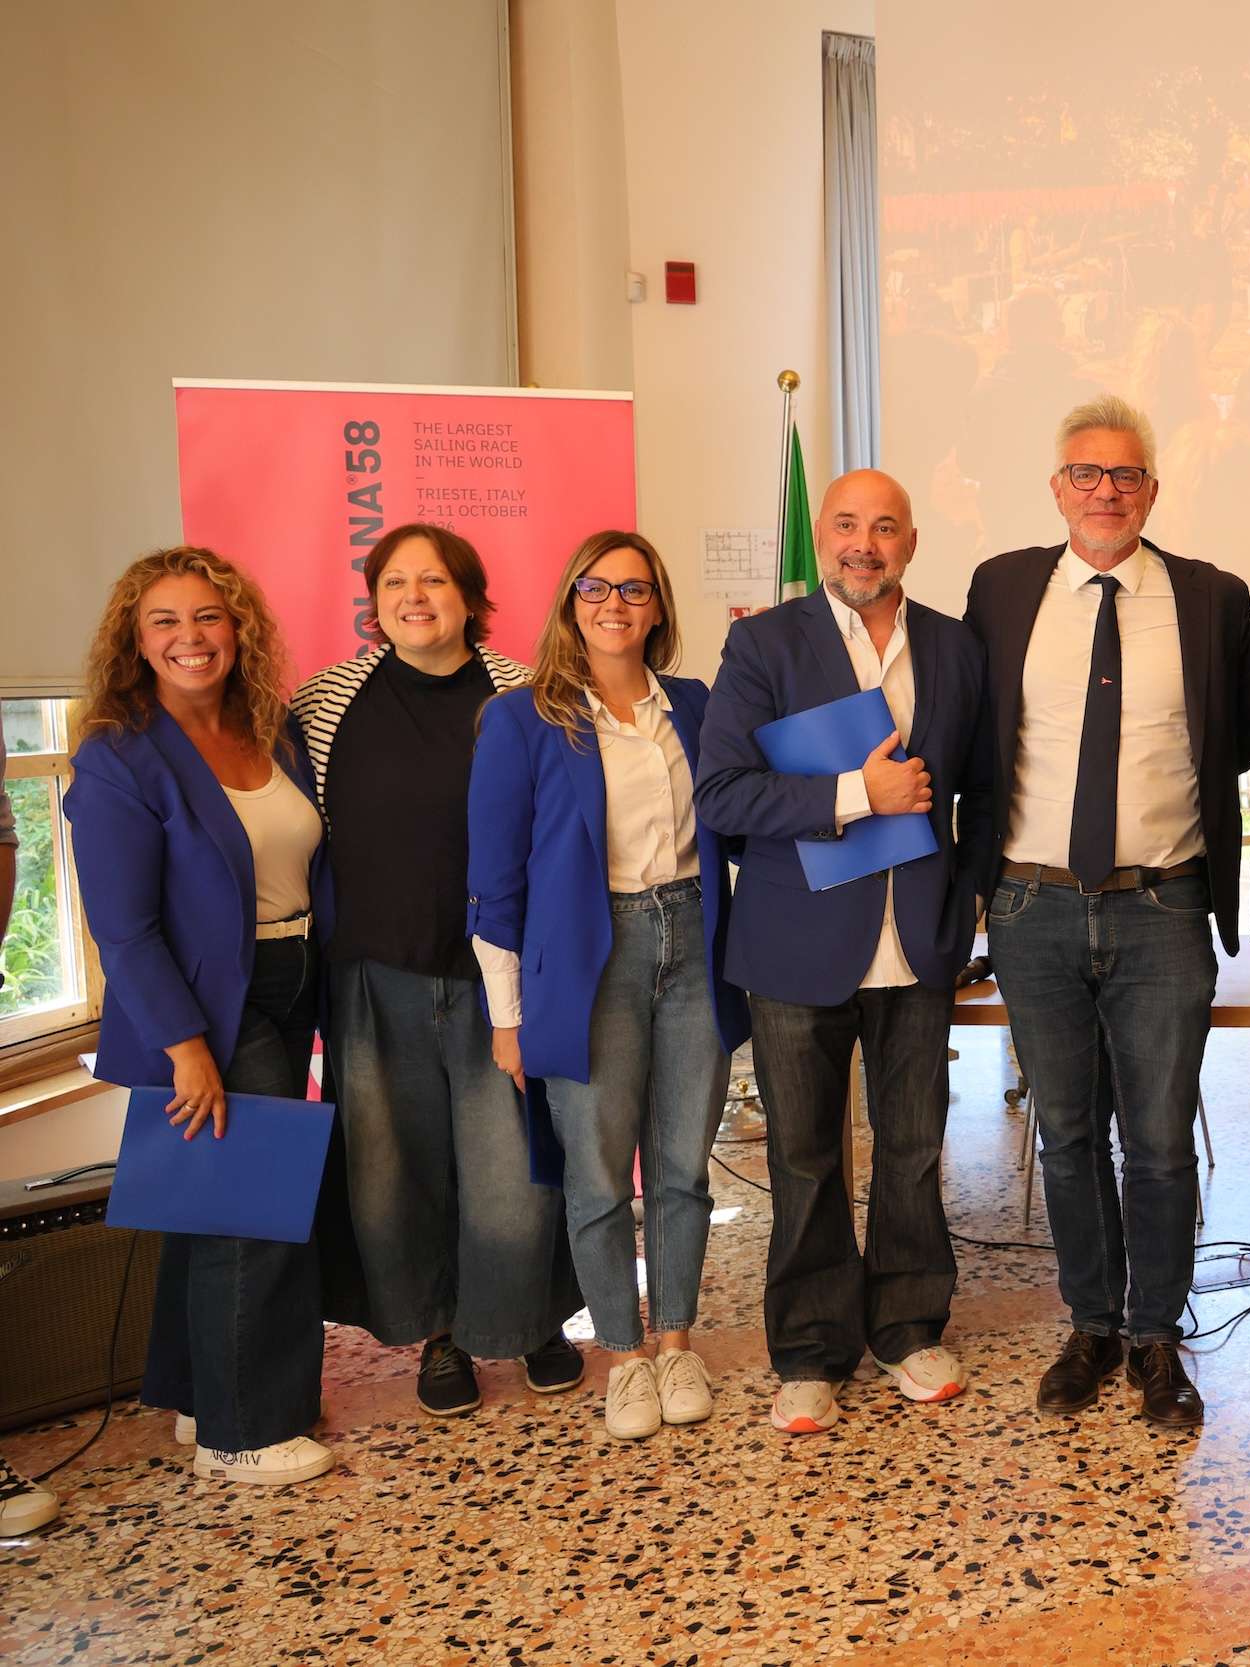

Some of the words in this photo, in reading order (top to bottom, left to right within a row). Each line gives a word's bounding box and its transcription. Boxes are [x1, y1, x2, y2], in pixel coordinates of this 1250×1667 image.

[414, 422, 442, 434] THE
[447, 424, 513, 436] LARGEST
[414, 439, 476, 452] SAILING
[481, 441, 519, 453] RACE
[415, 455, 432, 467] IN
[437, 456, 465, 468] THE
[470, 457, 522, 469] WORLD
[416, 488, 483, 502] TRIESTE,
[487, 489, 526, 501] ITALY
[458, 505, 528, 517] OCTOBER
